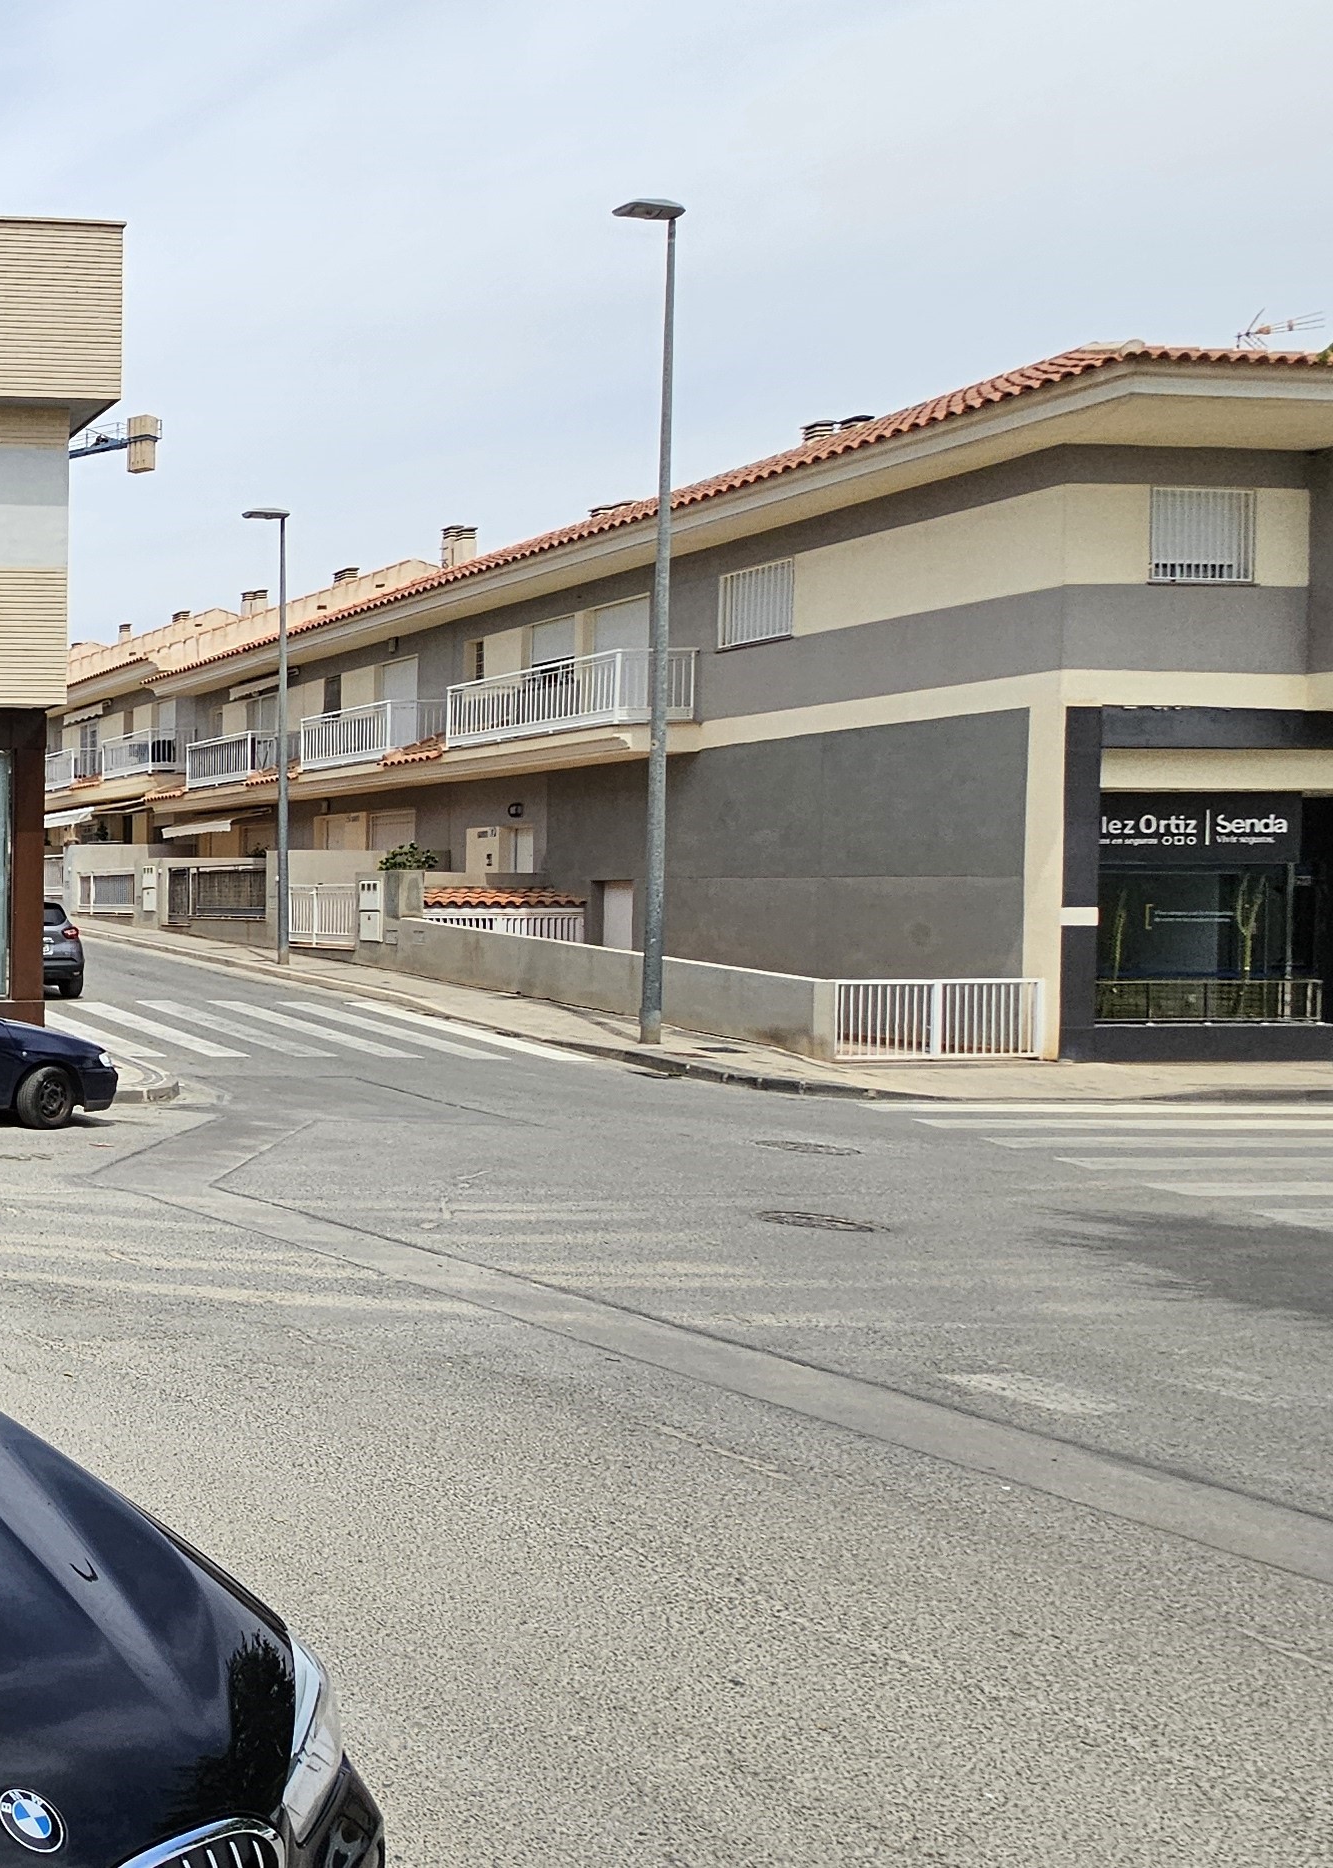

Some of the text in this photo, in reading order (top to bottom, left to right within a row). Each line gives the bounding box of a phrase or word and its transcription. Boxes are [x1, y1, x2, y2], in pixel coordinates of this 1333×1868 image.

[1101, 814, 1198, 834] lez Ortiz
[1215, 813, 1289, 834] Senda
[1, 1790, 43, 1813] BMW
